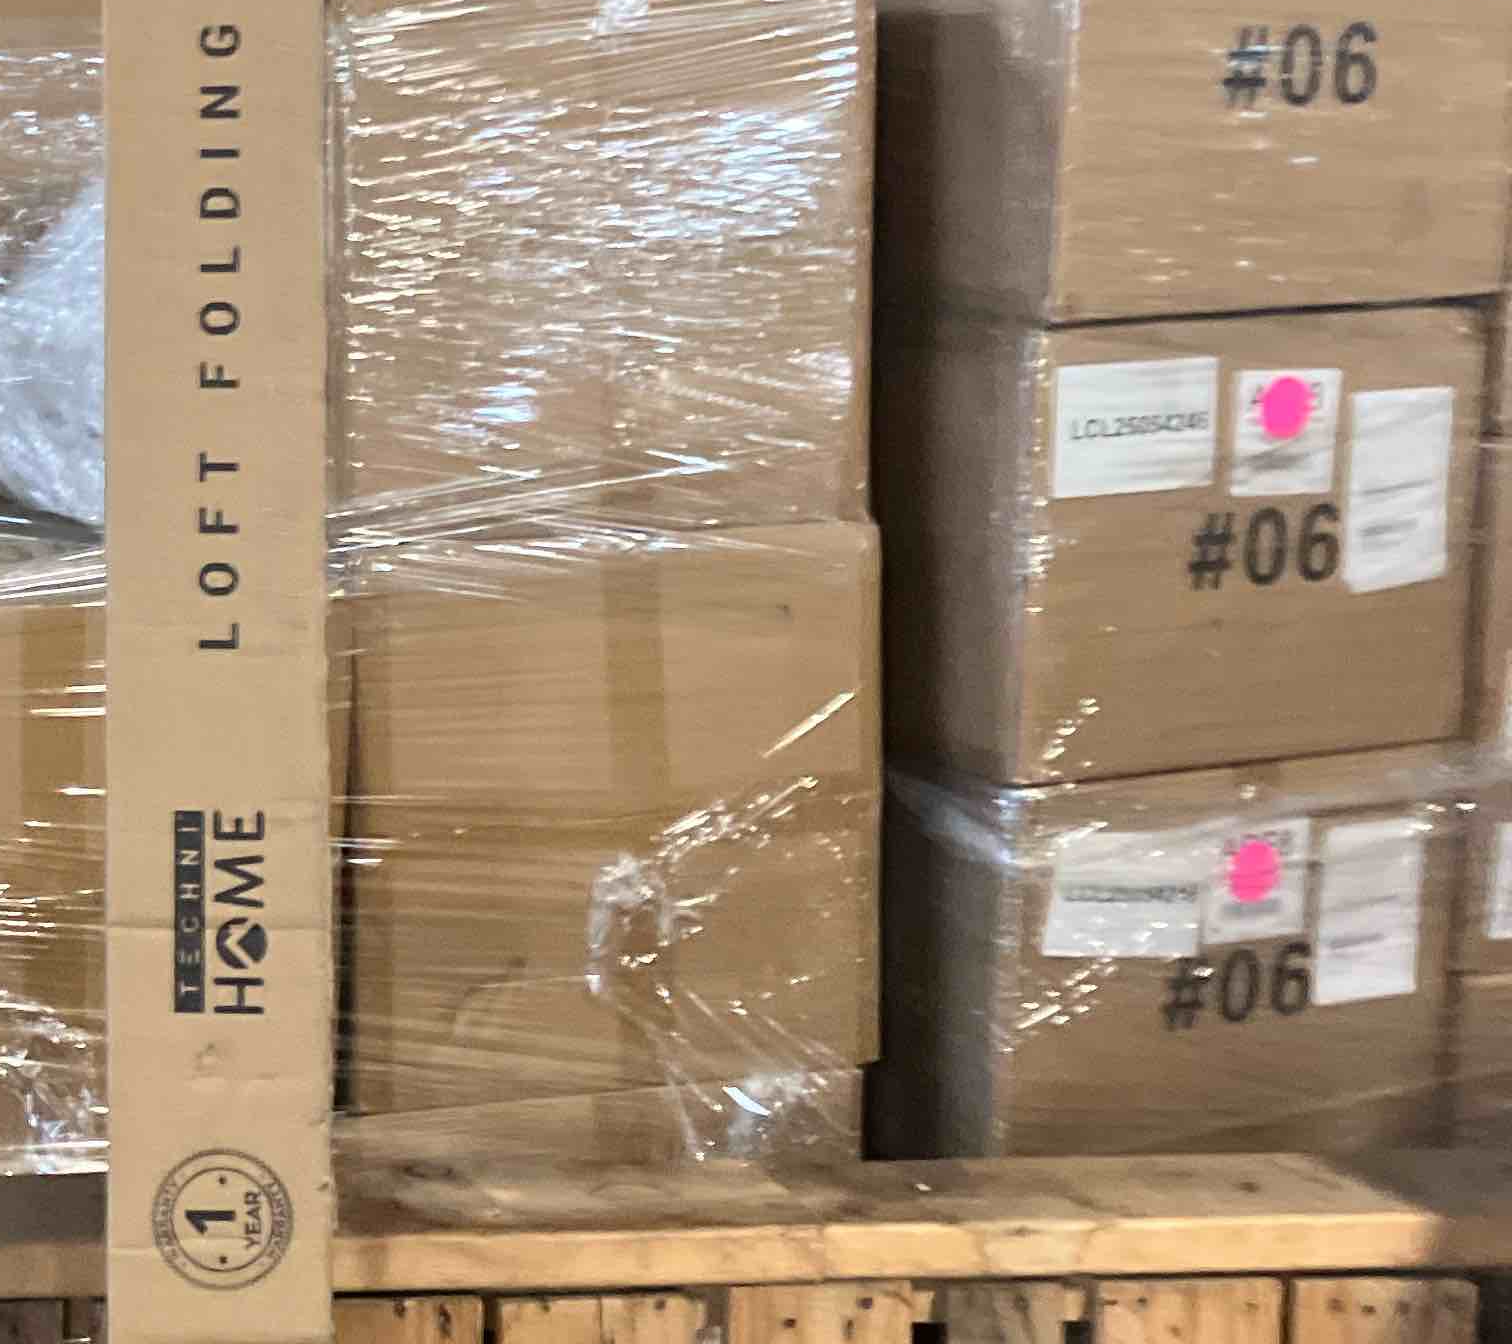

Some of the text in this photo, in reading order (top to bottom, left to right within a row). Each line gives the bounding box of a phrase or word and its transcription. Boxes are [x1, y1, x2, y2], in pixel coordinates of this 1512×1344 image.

[1223, 21, 1377, 108] #06
[198, 23, 241, 389] FOLDING
[198, 452, 241, 650] LOFT
[1187, 504, 1340, 590] #06
[177, 826, 201, 996] TECHNI
[213, 809, 268, 1015] HOME
[1163, 943, 1312, 1031] #06
[185, 1209, 236, 1235] 1
[244, 1189, 263, 1250] YEAR
